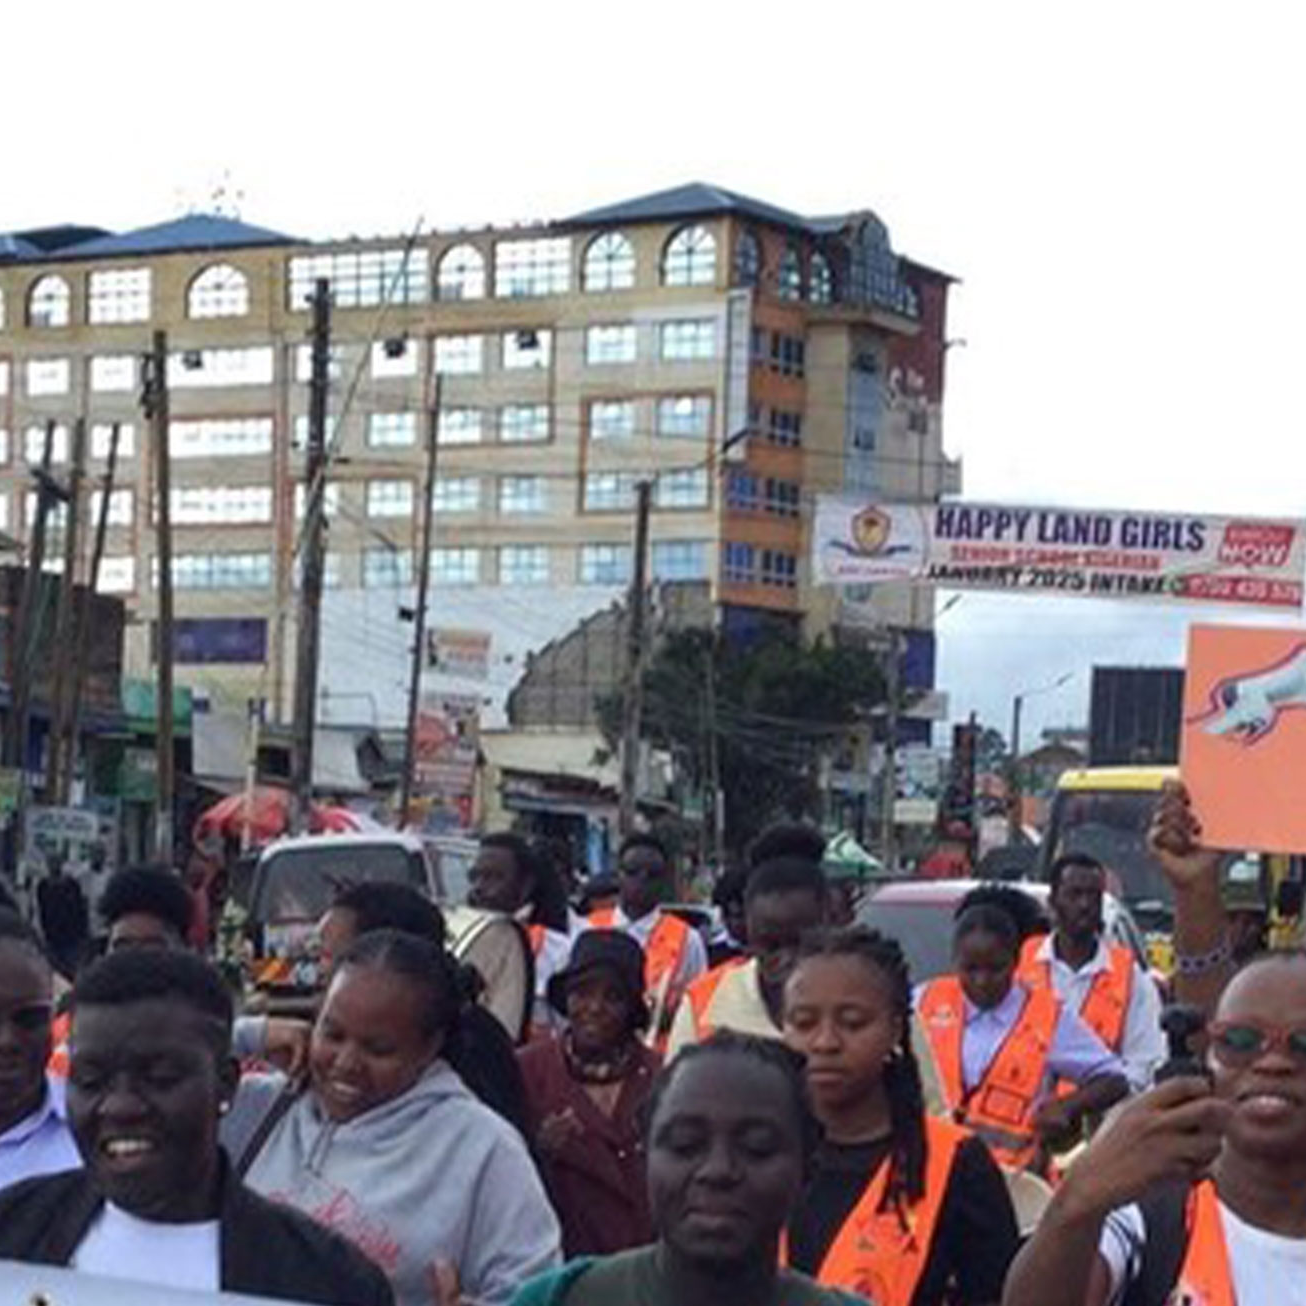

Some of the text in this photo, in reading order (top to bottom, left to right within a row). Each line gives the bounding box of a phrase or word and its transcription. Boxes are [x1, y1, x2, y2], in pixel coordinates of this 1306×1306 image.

[934, 508, 1206, 552] HAPPY LAND GIRLS
[927, 564, 1024, 586] JANUARY
[1028, 569, 1085, 592] 2025
[1091, 572, 1165, 594] INTAKE
